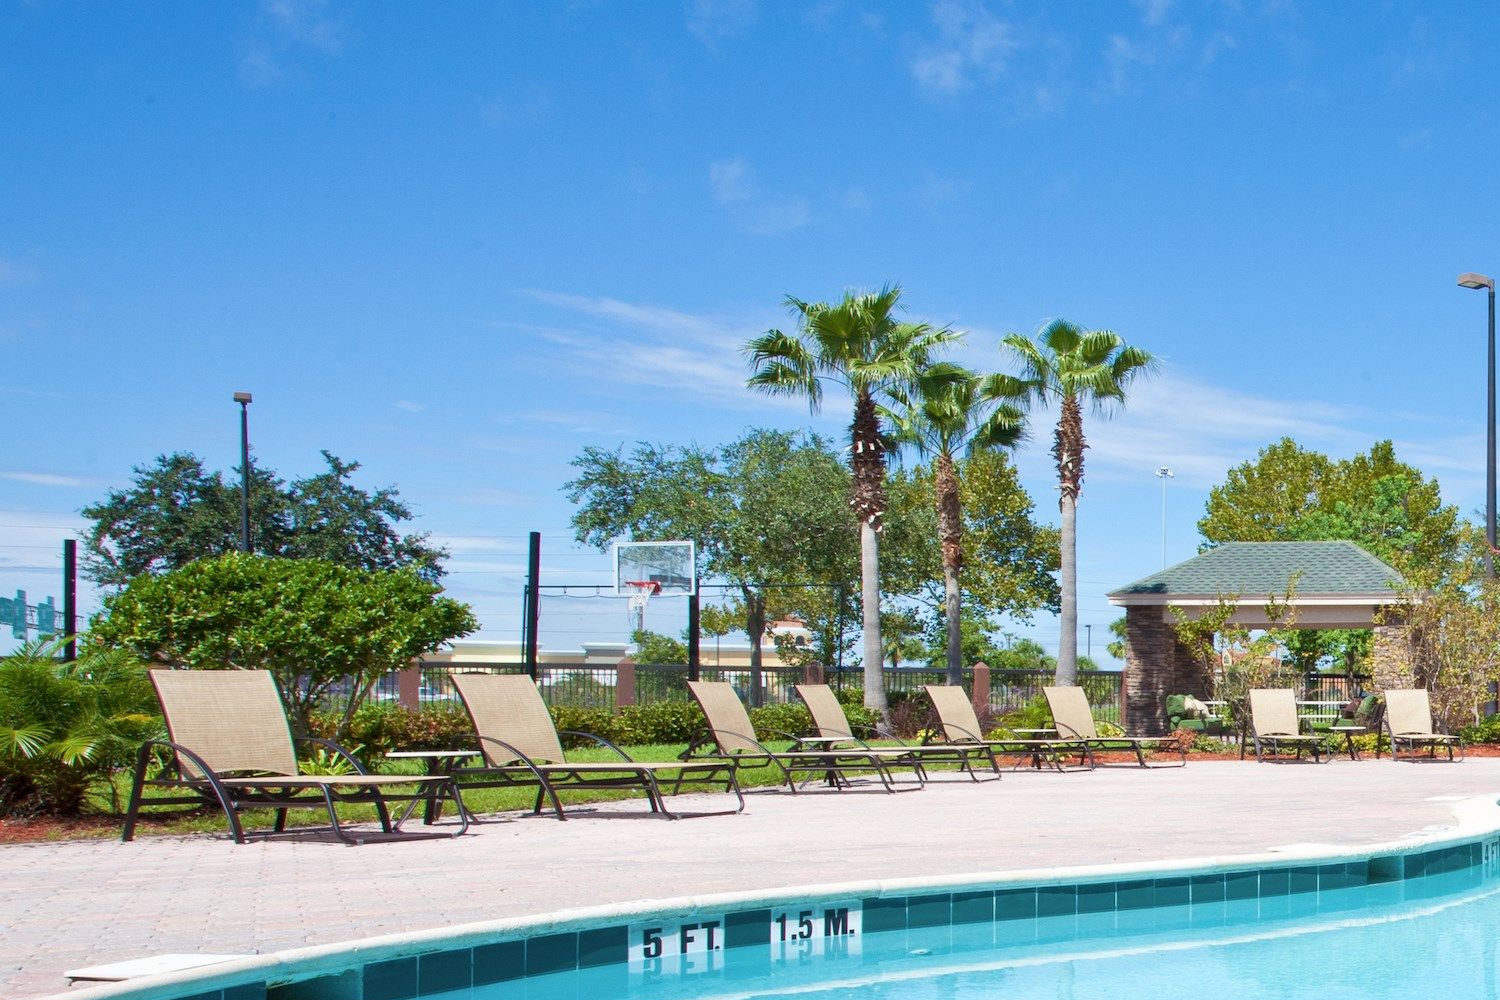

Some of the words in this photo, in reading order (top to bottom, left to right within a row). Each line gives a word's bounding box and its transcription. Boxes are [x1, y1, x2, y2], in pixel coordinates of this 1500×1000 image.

[643, 927, 663, 958] 5
[680, 920, 721, 954] FT.
[775, 910, 813, 942] 1.5
[824, 907, 855, 937] M.
